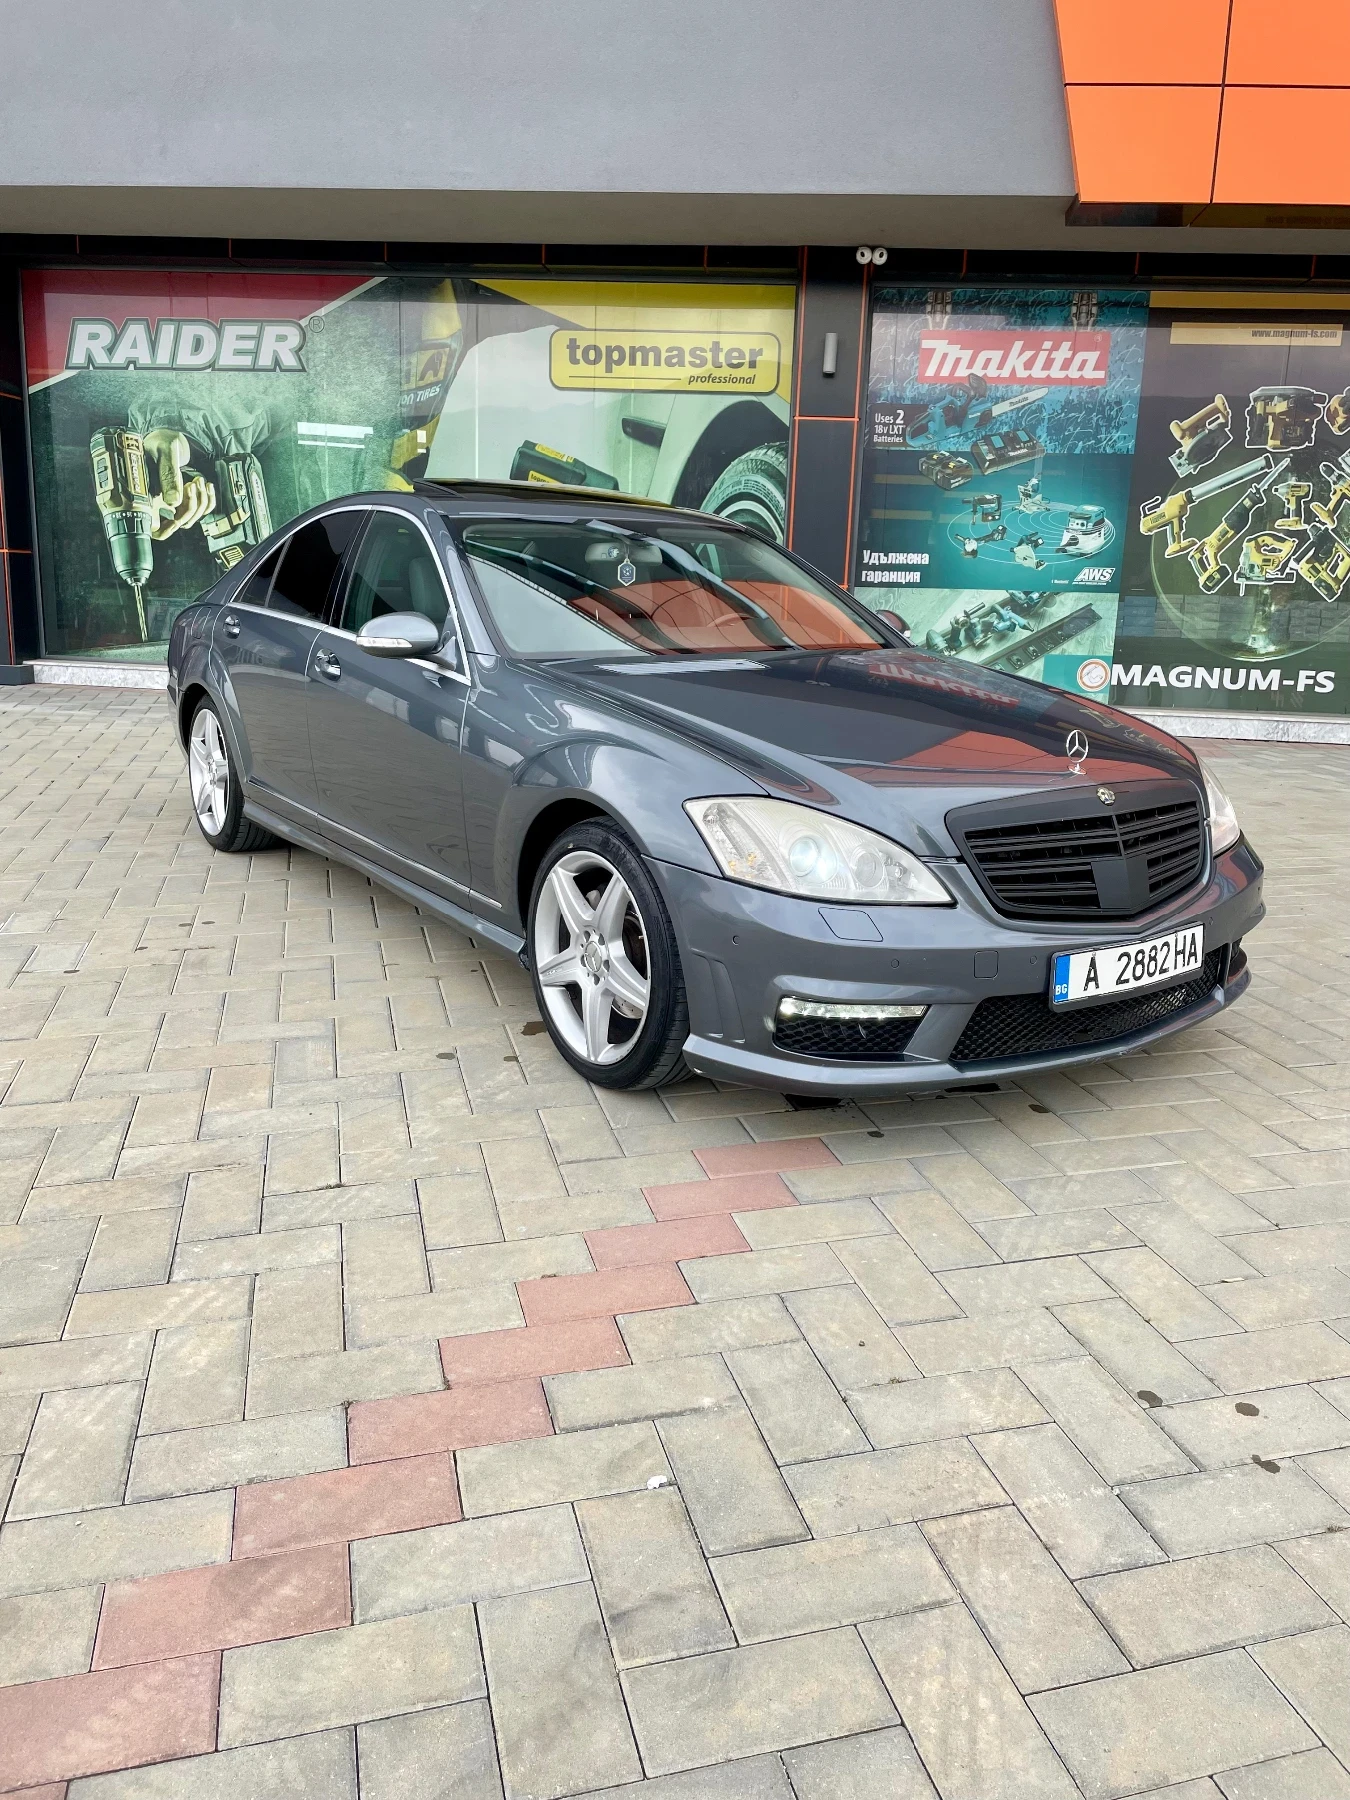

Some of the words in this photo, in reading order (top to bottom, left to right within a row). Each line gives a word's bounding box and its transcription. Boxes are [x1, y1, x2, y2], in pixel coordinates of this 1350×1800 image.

[1251, 329, 1338, 339] www.magnum-fs.com
[67, 319, 306, 370] RAIDER
[566, 337, 764, 373] topmaster
[688, 372, 756, 385] professional
[416, 383, 442, 402] TIRES
[875, 412, 894, 424] Uses
[895, 409, 905, 424] 2
[874, 424, 888, 434] 18v
[873, 434, 903, 443] Batteries
[862, 549, 930, 566] Удължена
[861, 570, 921, 585] гаранция
[1077, 568, 1113, 582] AWS
[1110, 663, 1336, 694] MAGNUM-FS
[1055, 984, 1068, 996] BG
